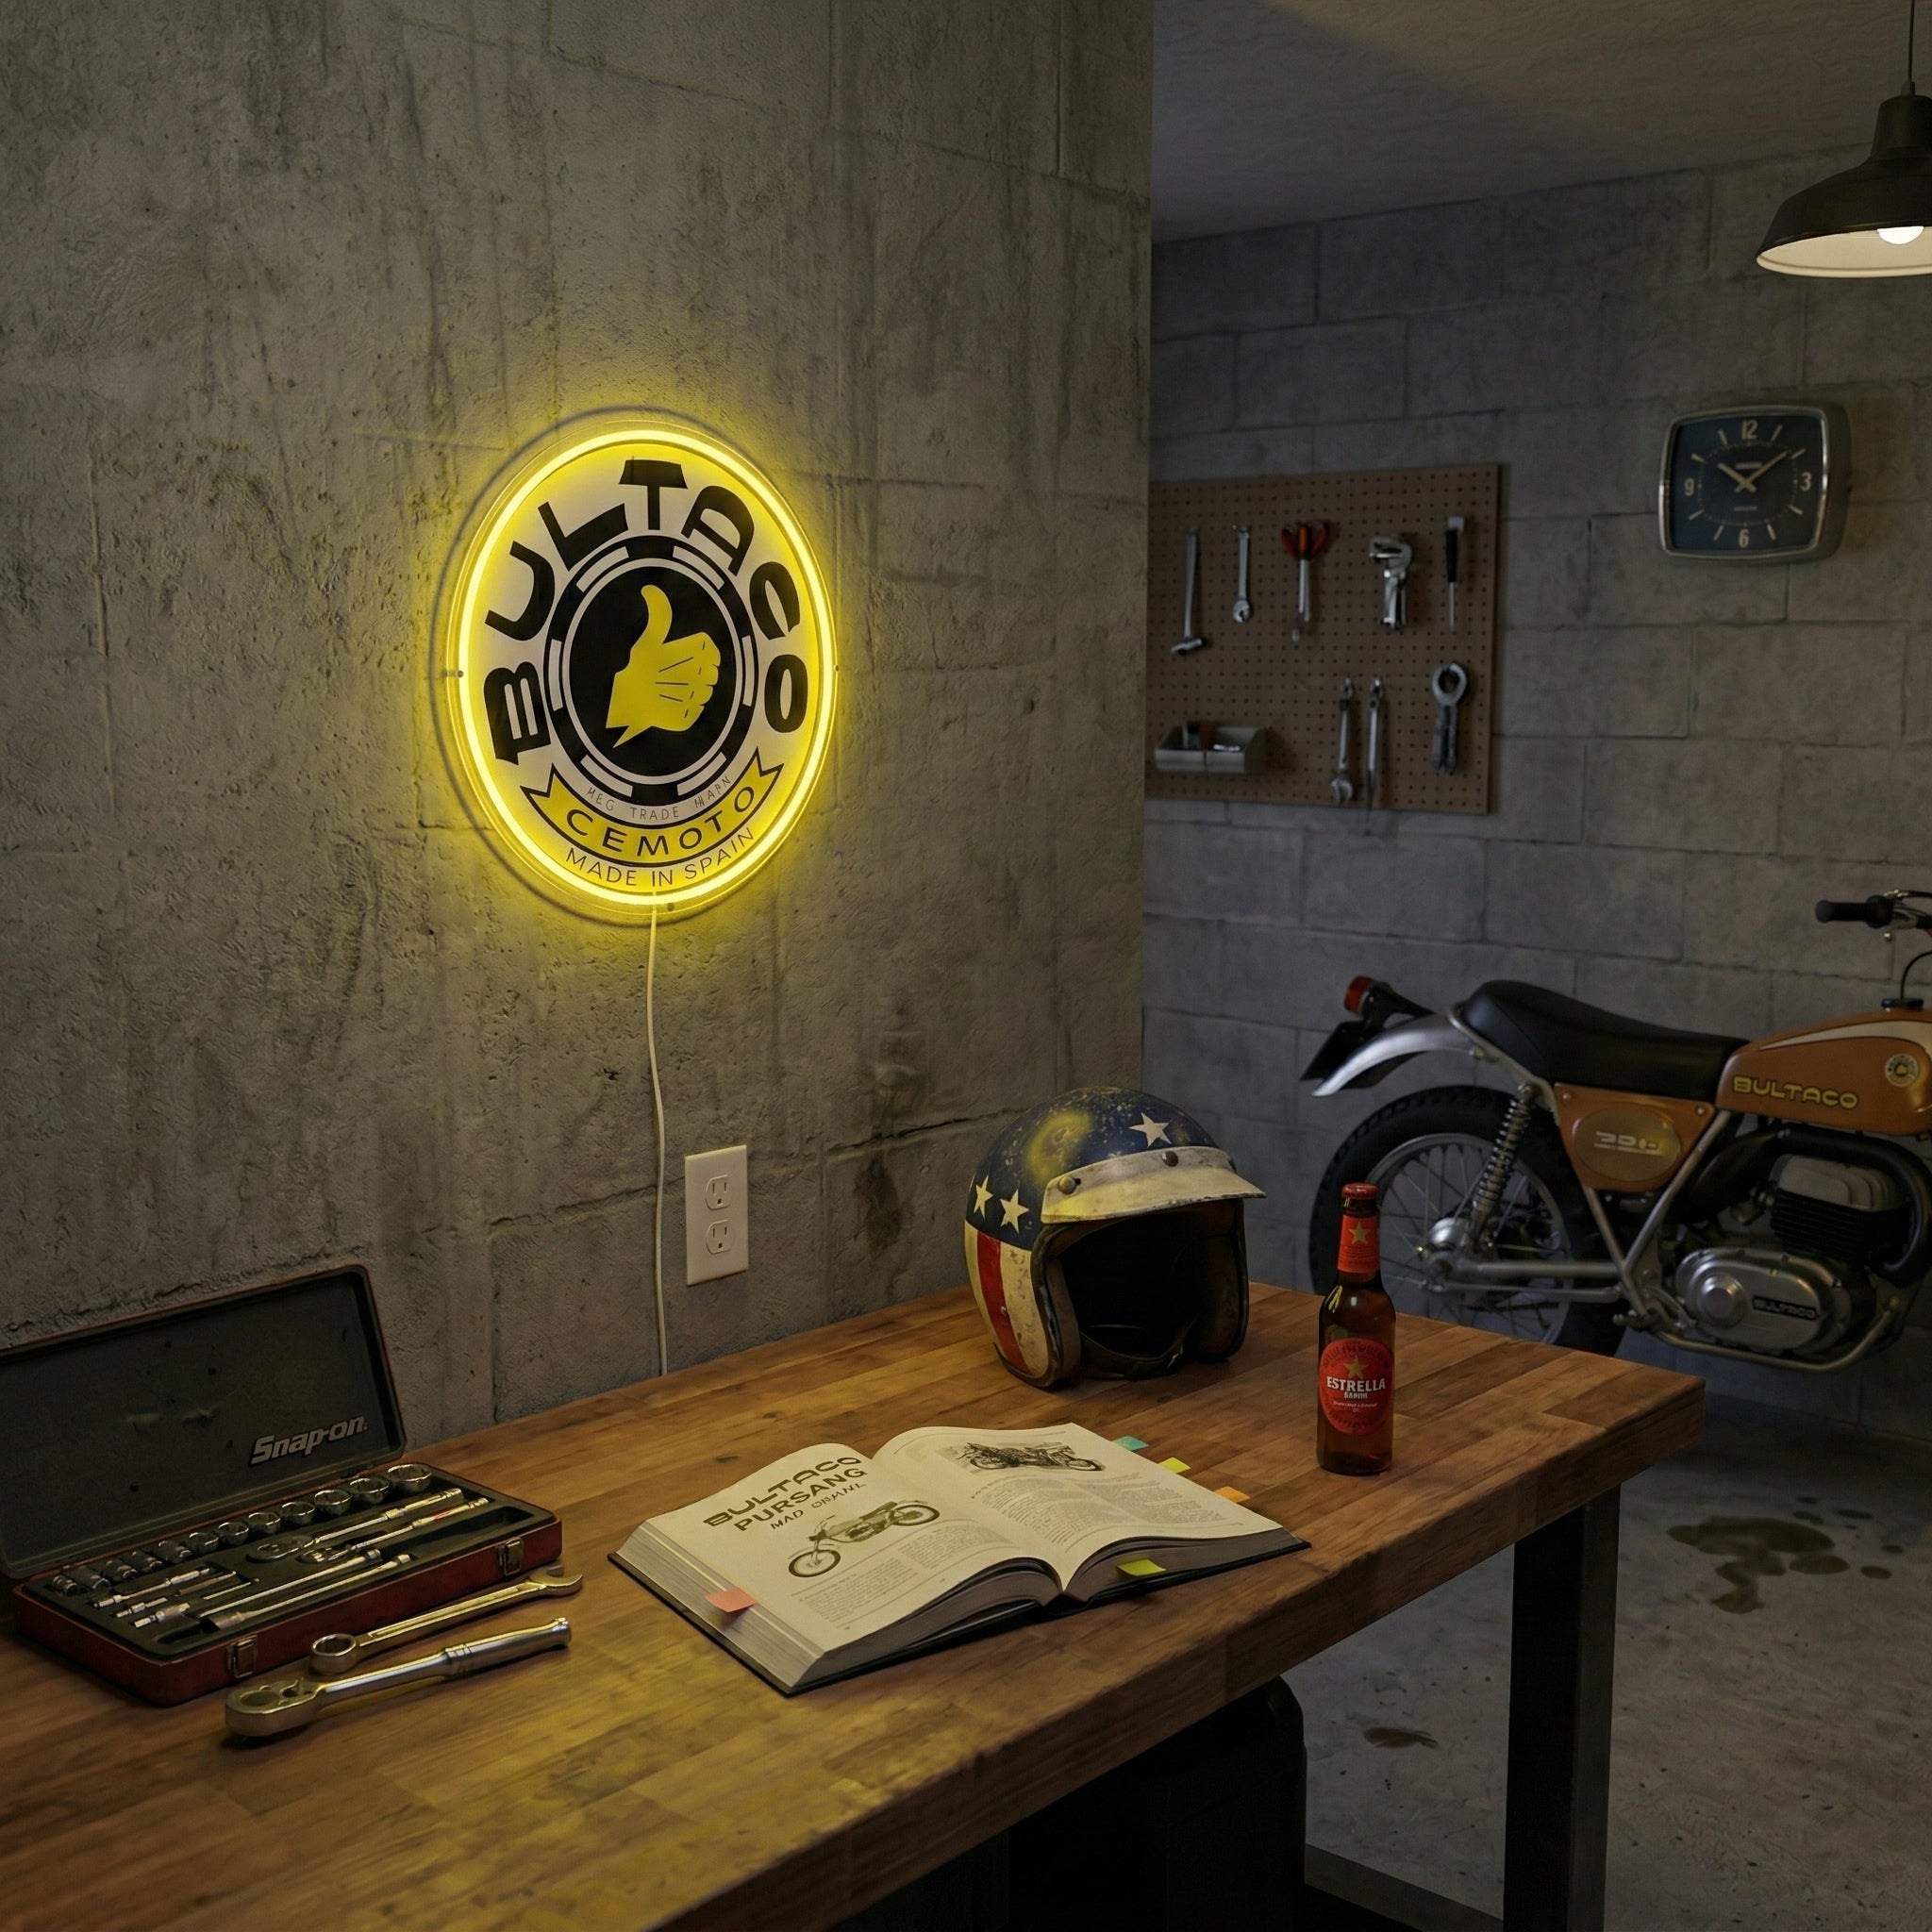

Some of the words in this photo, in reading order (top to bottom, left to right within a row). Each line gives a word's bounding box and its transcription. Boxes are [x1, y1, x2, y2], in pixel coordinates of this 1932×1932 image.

[1741, 420, 1758, 440] 12
[1684, 477, 1695, 496] 9
[1800, 472, 1812, 491] 3
[1739, 528, 1750, 548] 6
[484, 456, 808, 766] BULTACO
[566, 786, 755, 857] CEMOTO
[629, 807, 679, 820] TRADE
[566, 847, 638, 887] MADE
[651, 870, 674, 888] IN
[685, 826, 755, 880] SPAIN
[1733, 1075, 1858, 1109] BULTACO
[1326, 1375, 1386, 1392] ESTRELLA
[250, 1416, 366, 1465] Snap-on
[703, 1457, 862, 1527] BULTACO
[733, 1468, 868, 1532] PURSANG
